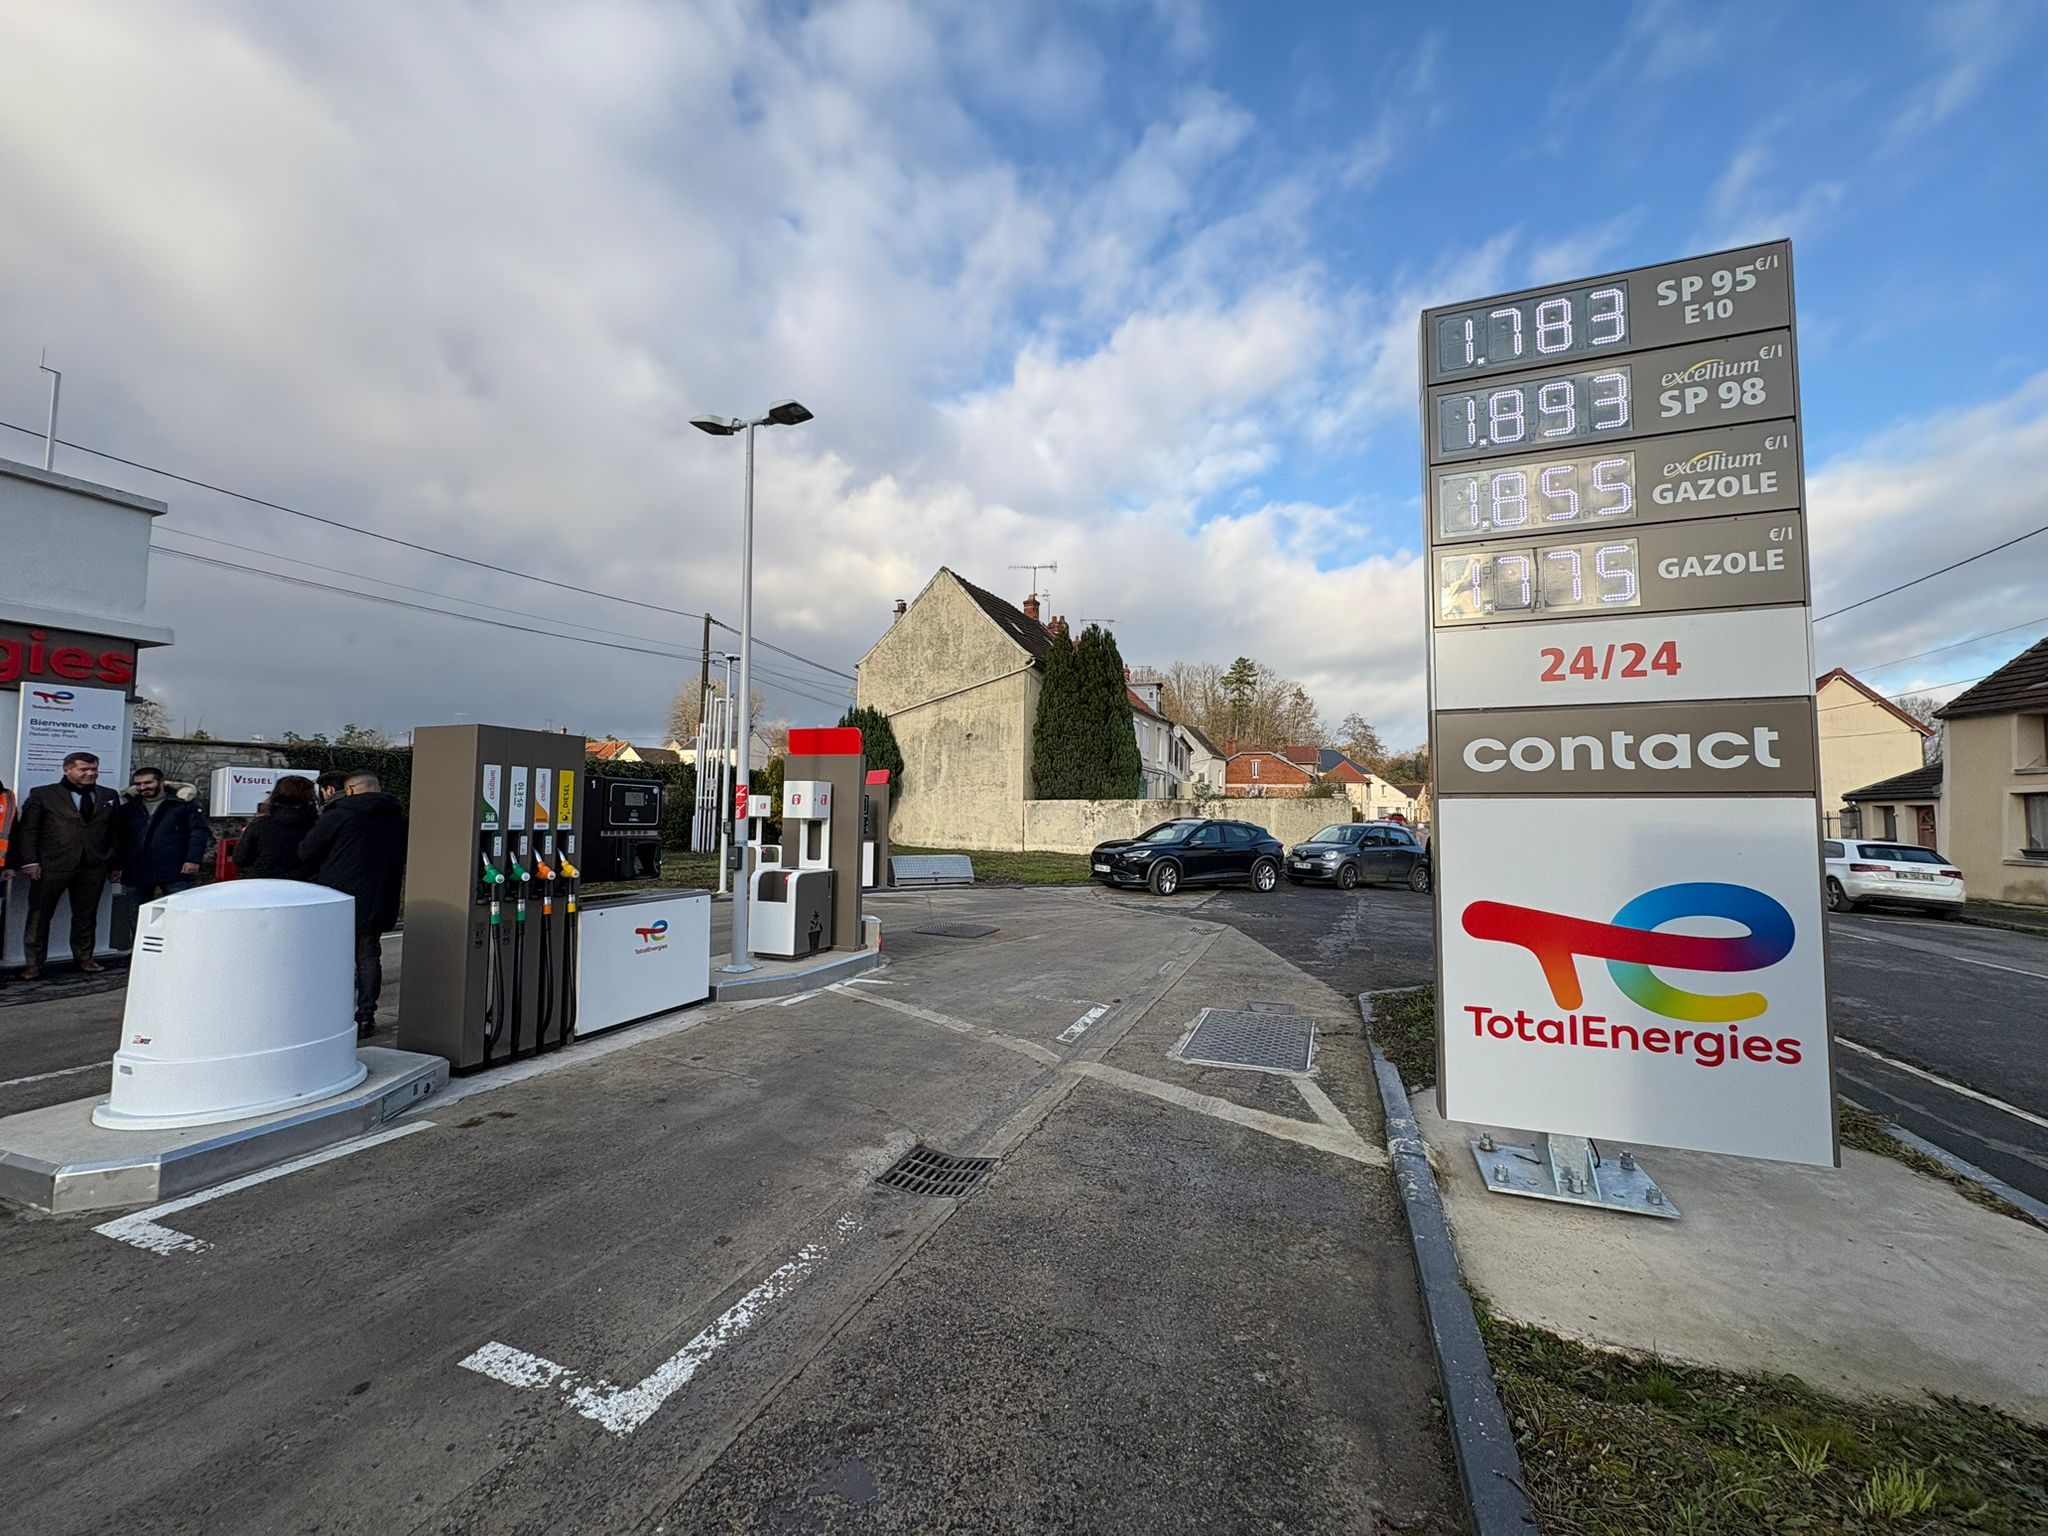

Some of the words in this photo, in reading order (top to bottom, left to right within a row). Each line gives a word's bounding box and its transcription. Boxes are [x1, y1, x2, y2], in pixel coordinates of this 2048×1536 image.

[1656, 275, 1704, 307] SP
[1711, 264, 1757, 297] 95
[1465, 288, 1625, 367] 1.783
[1684, 298, 1734, 325] E10
[1661, 359, 1760, 388] excellium
[1467, 372, 1628, 446] 1.893
[1659, 386, 1709, 418] SP
[1718, 377, 1767, 410] 98
[1663, 450, 1762, 478] excellium
[1469, 458, 1633, 528] 1.855
[1651, 470, 1779, 505] GAZOLE
[1657, 548, 1785, 579] GAZOLE
[1540, 640, 1682, 682] 24/24
[30, 718, 89, 730] Bienvenue
[91, 722, 117, 731] chez
[1463, 726, 1781, 773] contact
[591, 780, 596, 789] 1
[485, 814, 496, 822] 98
[1464, 1005, 1802, 1067] TotalEnergies
